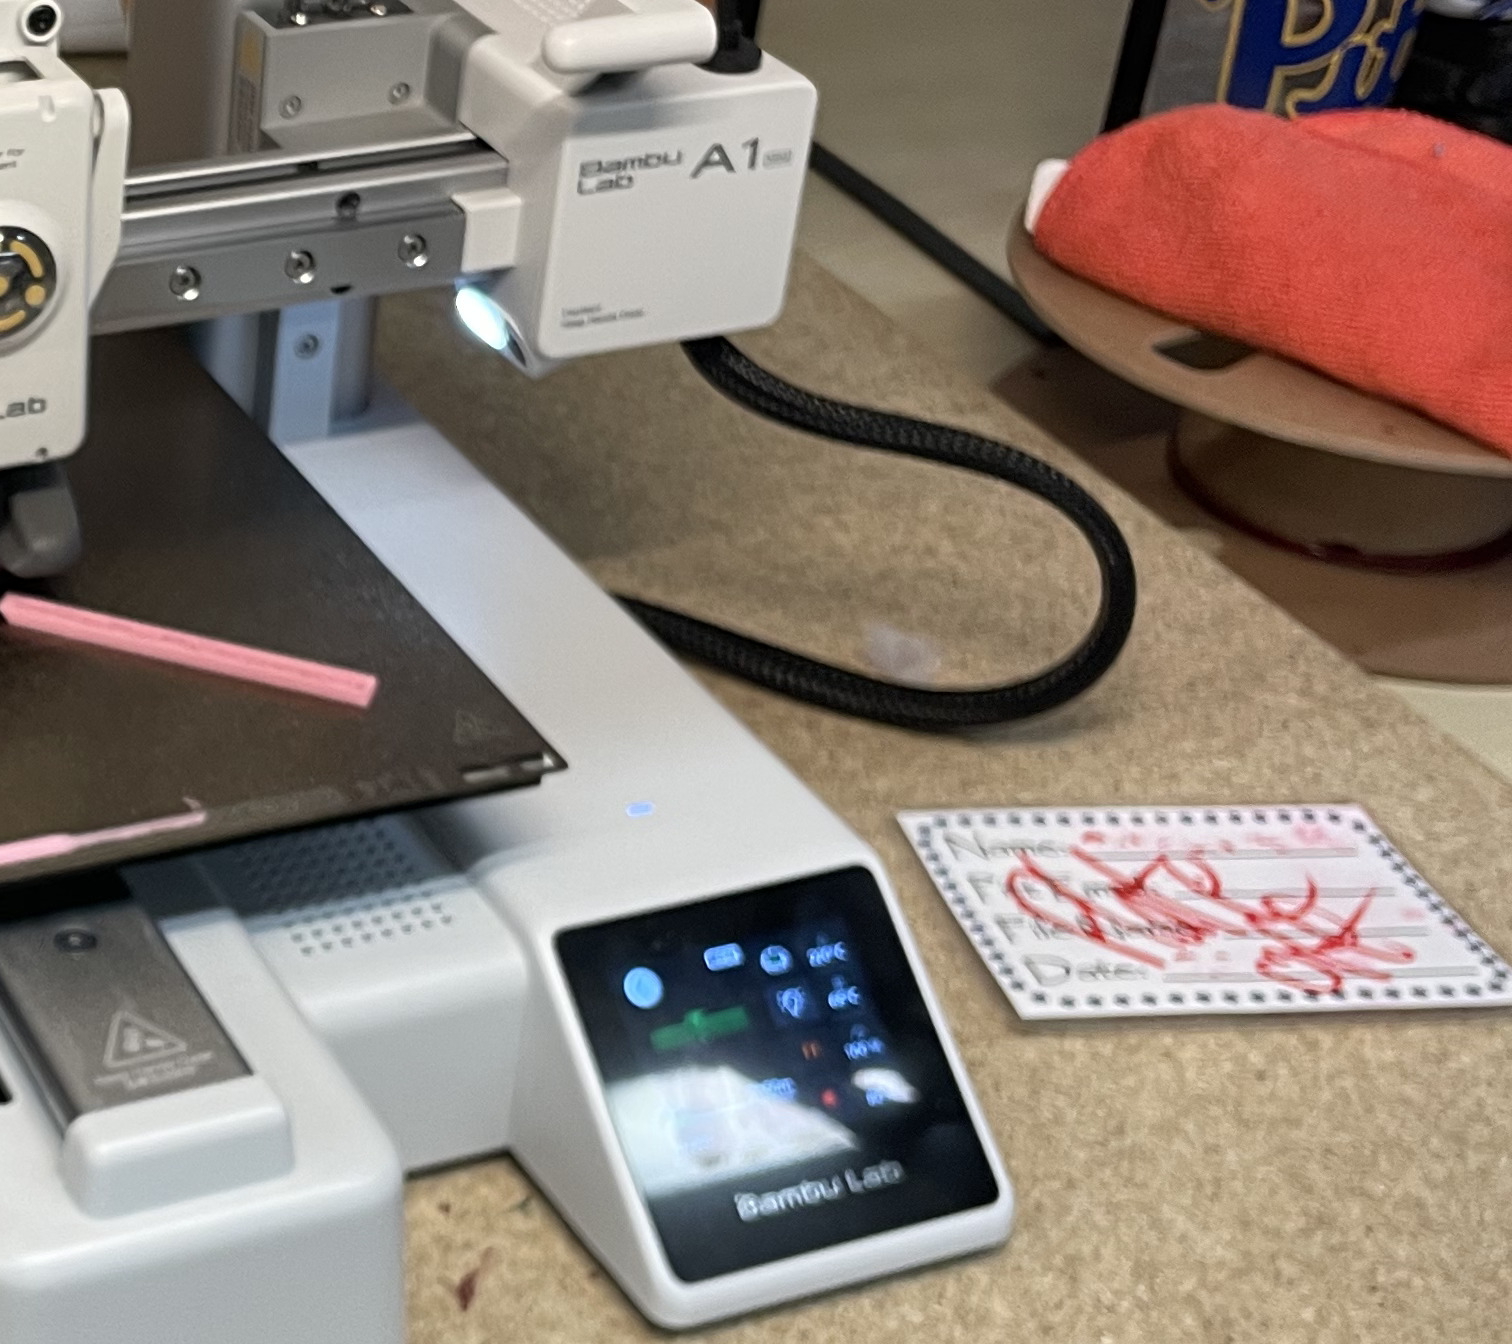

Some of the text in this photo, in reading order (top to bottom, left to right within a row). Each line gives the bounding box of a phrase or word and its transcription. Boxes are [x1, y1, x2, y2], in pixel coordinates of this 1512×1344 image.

[579, 149, 683, 179] Bambu
[689, 136, 760, 180] A1
[734, 1159, 905, 1223] Bambu Lab
